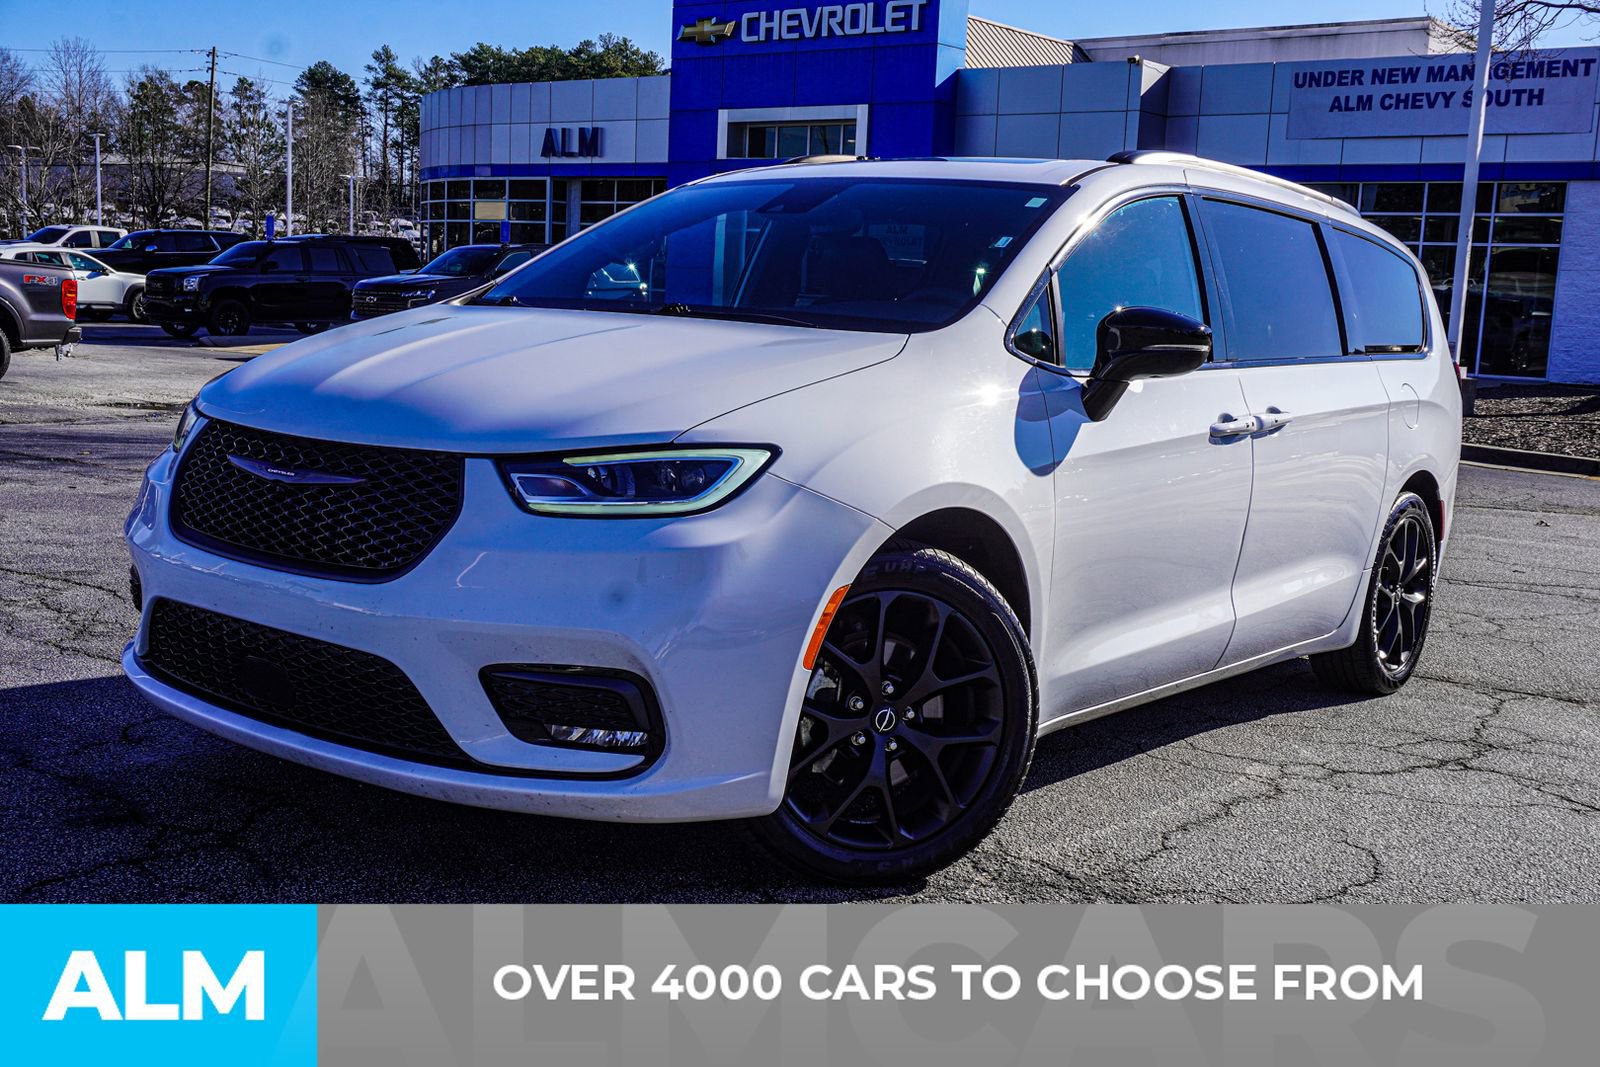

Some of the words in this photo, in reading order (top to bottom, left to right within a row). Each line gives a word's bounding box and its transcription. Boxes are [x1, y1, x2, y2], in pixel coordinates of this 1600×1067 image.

[741, 0, 927, 43] CHEVROLET
[1294, 69, 1365, 89] UNDER
[1370, 66, 1422, 86] NEW
[1426, 58, 1597, 83] MANGEMENT
[1328, 94, 1374, 112] ALM
[1380, 91, 1456, 111] CHEVY
[540, 127, 606, 158] ALM
